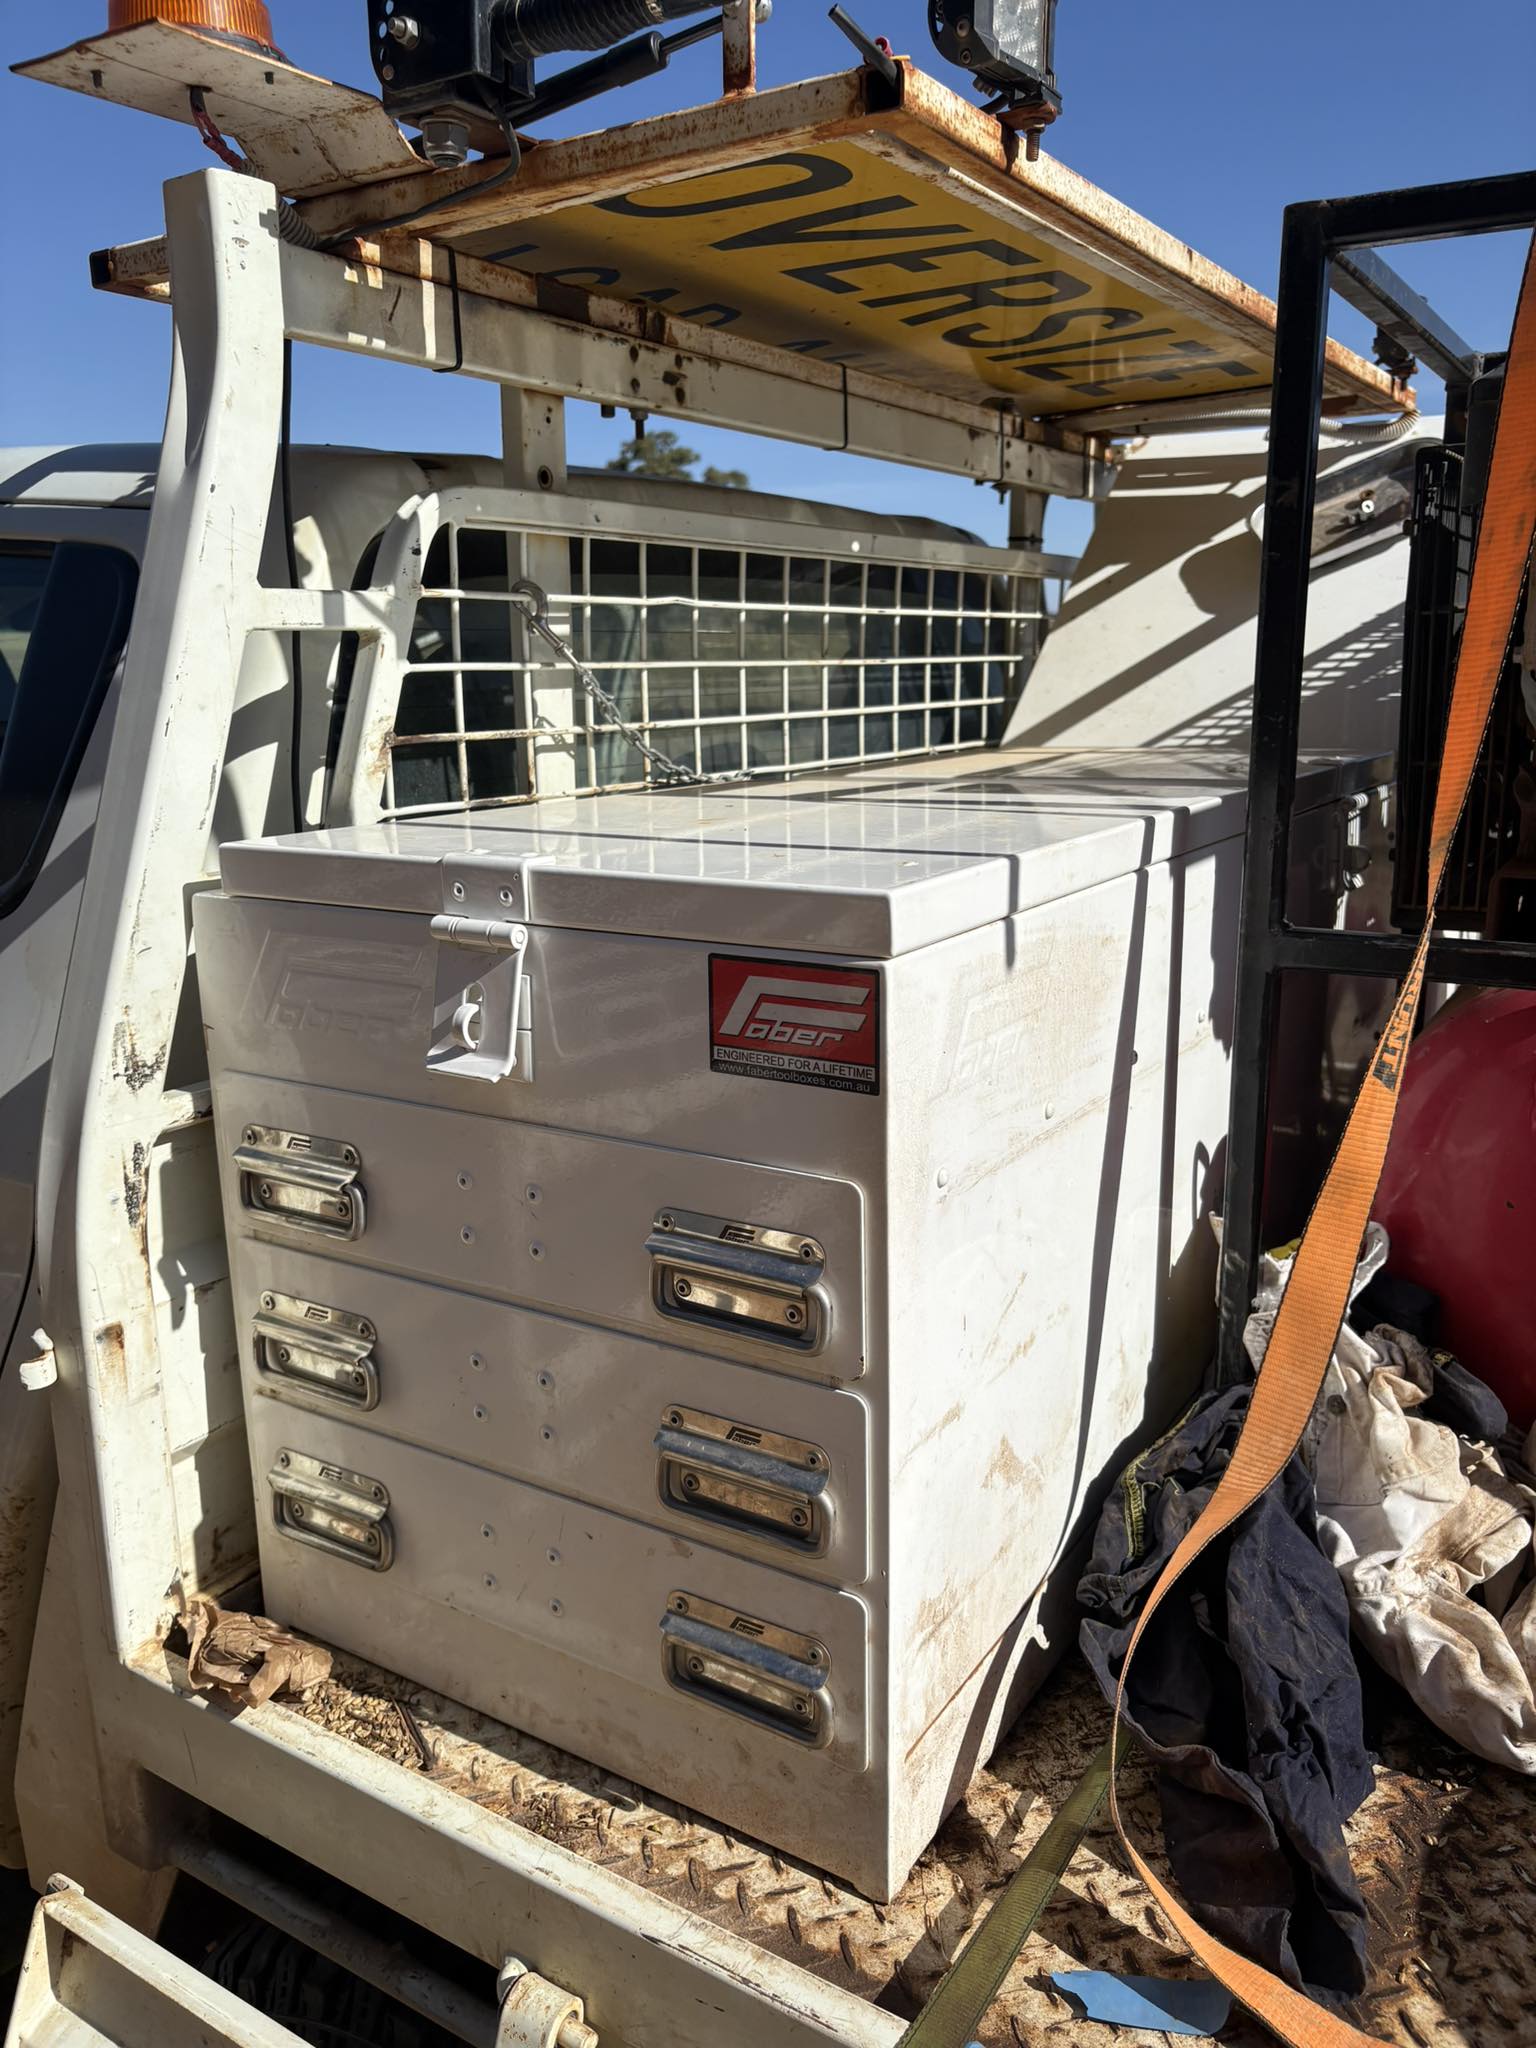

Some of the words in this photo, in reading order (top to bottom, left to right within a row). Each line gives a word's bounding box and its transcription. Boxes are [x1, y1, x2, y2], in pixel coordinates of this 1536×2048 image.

[592, 152, 1259, 397] OVERSIZE
[719, 975, 871, 1048] Faber
[716, 1048, 785, 1067] ENGINEERED
[787, 1058, 811, 1071] FOR
[813, 1061, 823, 1073] A
[822, 1063, 874, 1080] LIFETIME
[718, 1062, 871, 1093] www.fabertoolboxes.com.au
